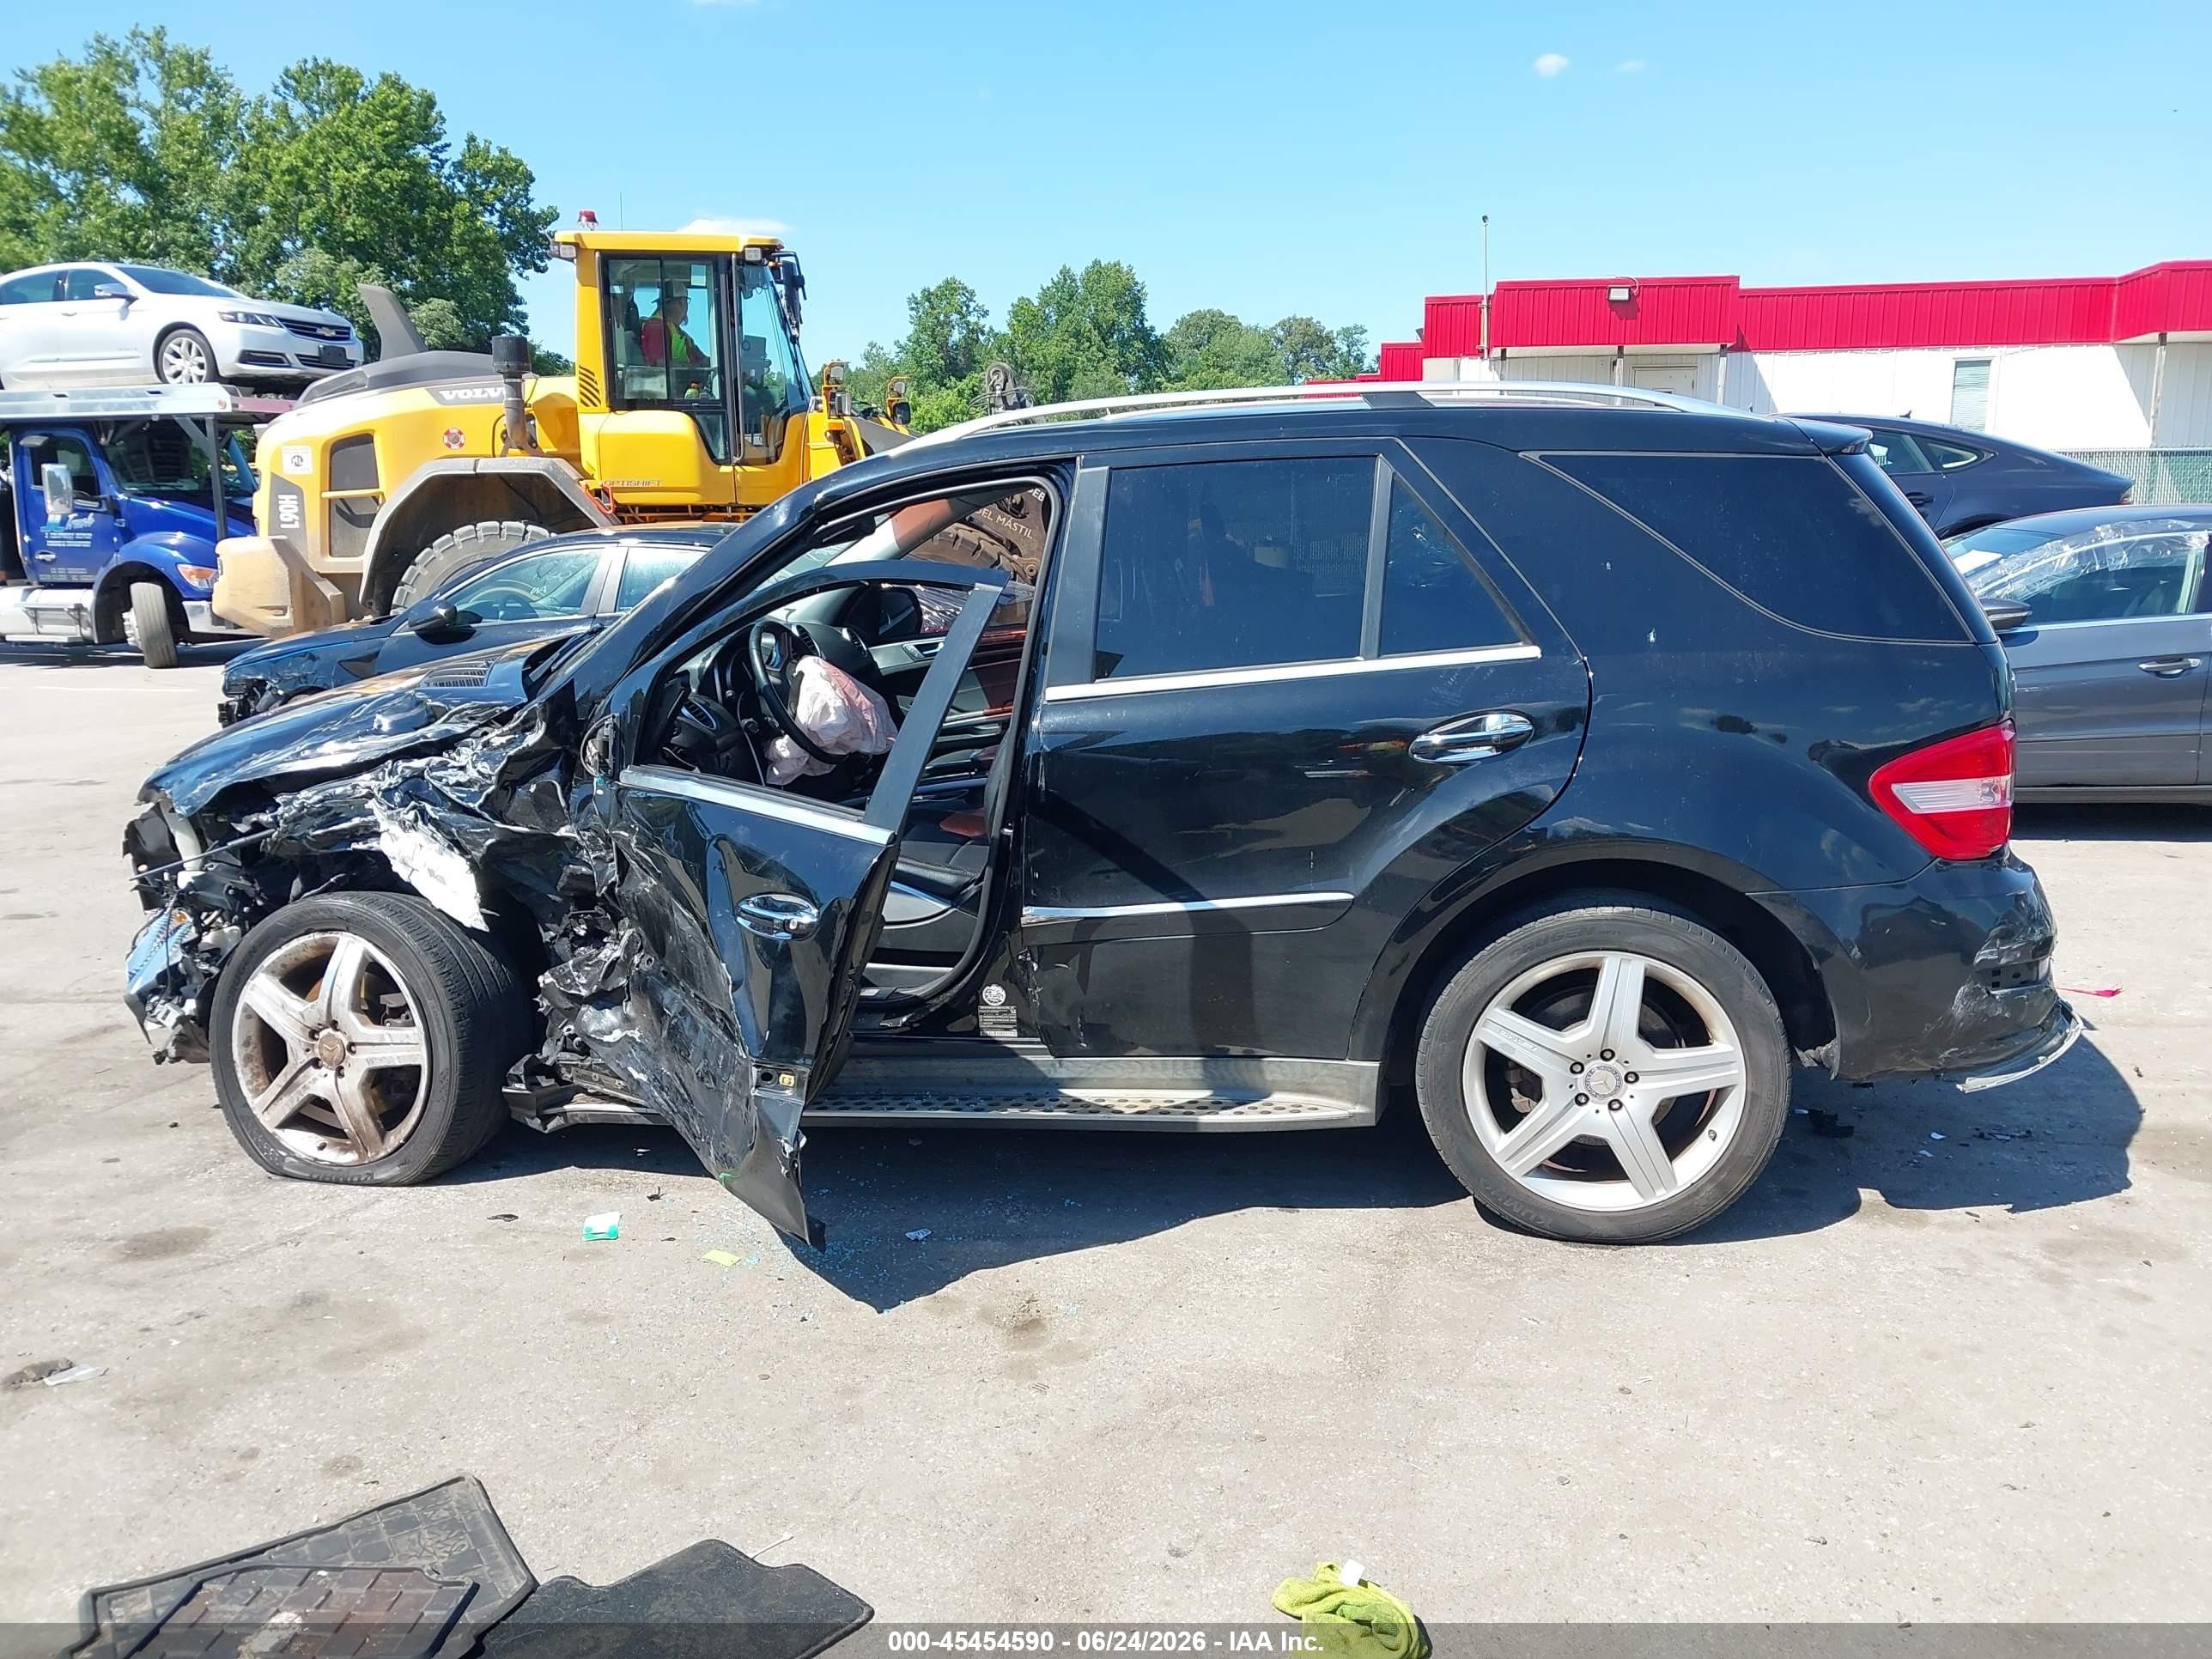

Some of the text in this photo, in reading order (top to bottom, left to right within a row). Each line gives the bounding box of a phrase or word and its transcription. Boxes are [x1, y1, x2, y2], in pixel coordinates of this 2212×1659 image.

[439, 386, 505, 400] VOLV
[277, 495, 300, 529] L90H
[996, 515, 1033, 539] MÁSTIL
